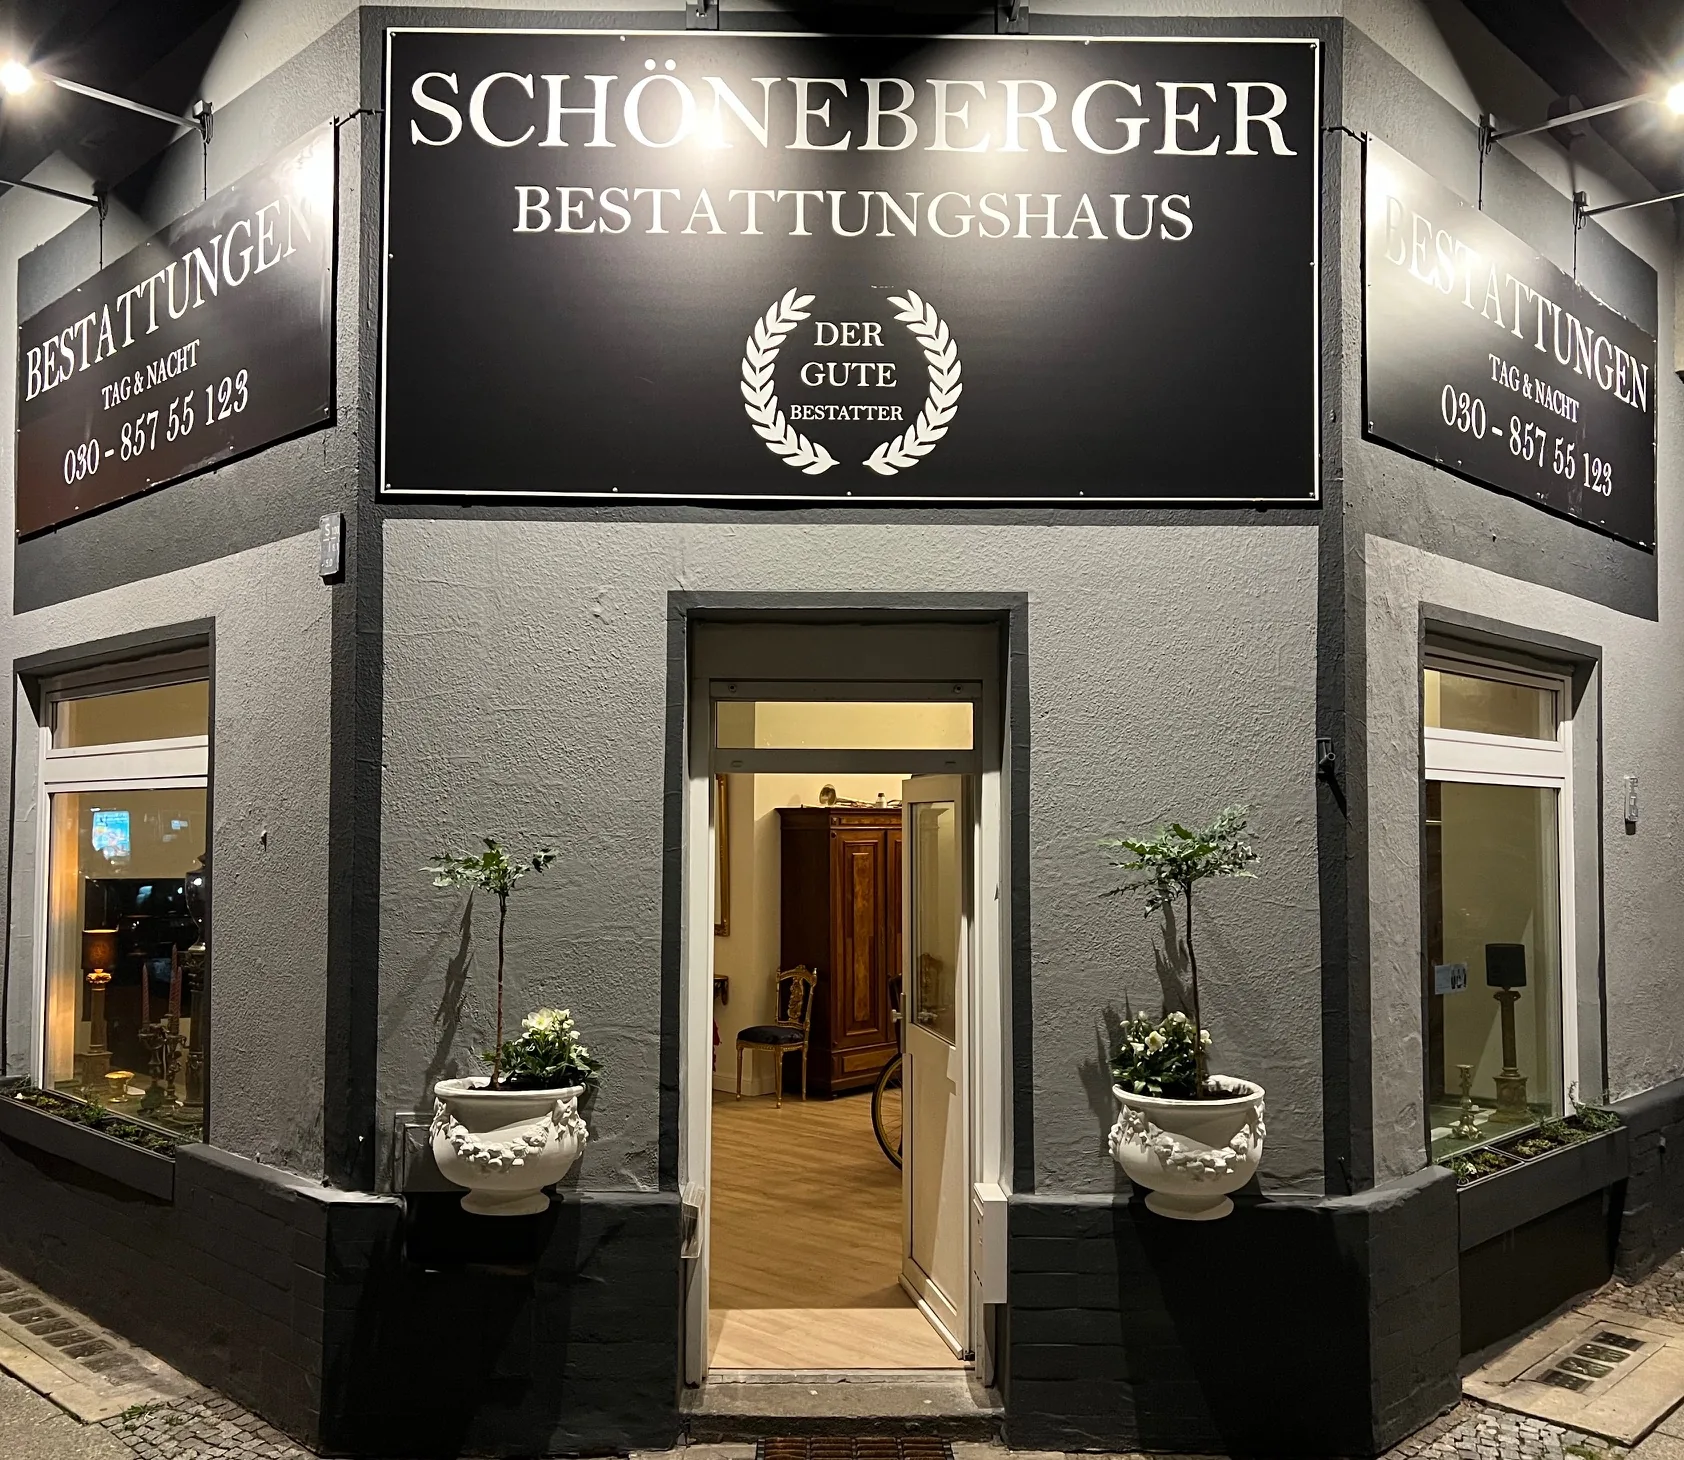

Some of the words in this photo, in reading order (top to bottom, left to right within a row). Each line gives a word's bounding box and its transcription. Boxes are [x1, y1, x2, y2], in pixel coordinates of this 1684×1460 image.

[411, 58, 1297, 157] SCHÖNEBERGER
[512, 185, 1194, 241] BESTATTUNGSHAUS
[25, 194, 313, 403] BESTATTUNGEN
[814, 321, 884, 347] DER
[1385, 195, 1650, 413] BESTATTUNGEN
[101, 376, 131, 411] TAG
[133, 371, 145, 394] &
[146, 339, 200, 383] NACHT
[799, 362, 898, 388] GUTE
[1488, 353, 1520, 392] TAG
[1522, 376, 1533, 399] &
[1534, 379, 1580, 424] NACHT
[63, 438, 100, 485] 030
[120, 410, 159, 462] 857
[166, 390, 195, 443] 55
[205, 369, 249, 426] 123
[790, 404, 904, 422] BESTATTER
[1441, 384, 1487, 440] 030
[1509, 415, 1547, 469] 857
[1552, 437, 1576, 480] 55
[1583, 452, 1613, 497] 123
